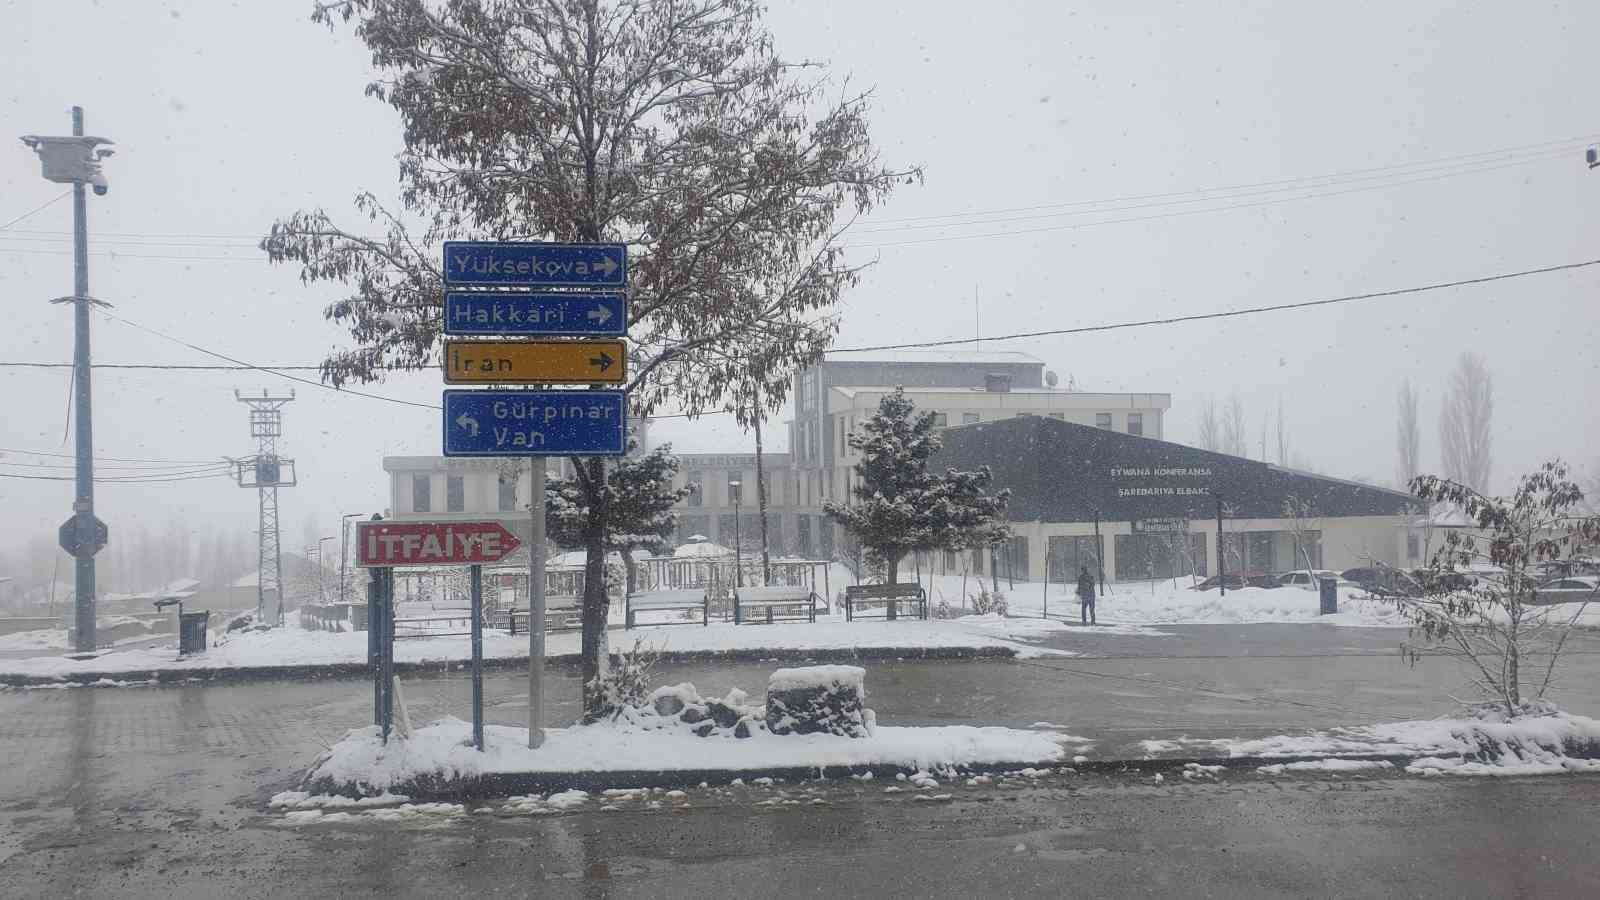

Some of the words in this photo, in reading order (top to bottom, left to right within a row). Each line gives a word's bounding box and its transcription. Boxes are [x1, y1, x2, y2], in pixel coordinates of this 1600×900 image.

[454, 254, 591, 275] Yüksekova
[493, 428, 545, 446] Van
[368, 527, 502, 560] İTFAİYE
